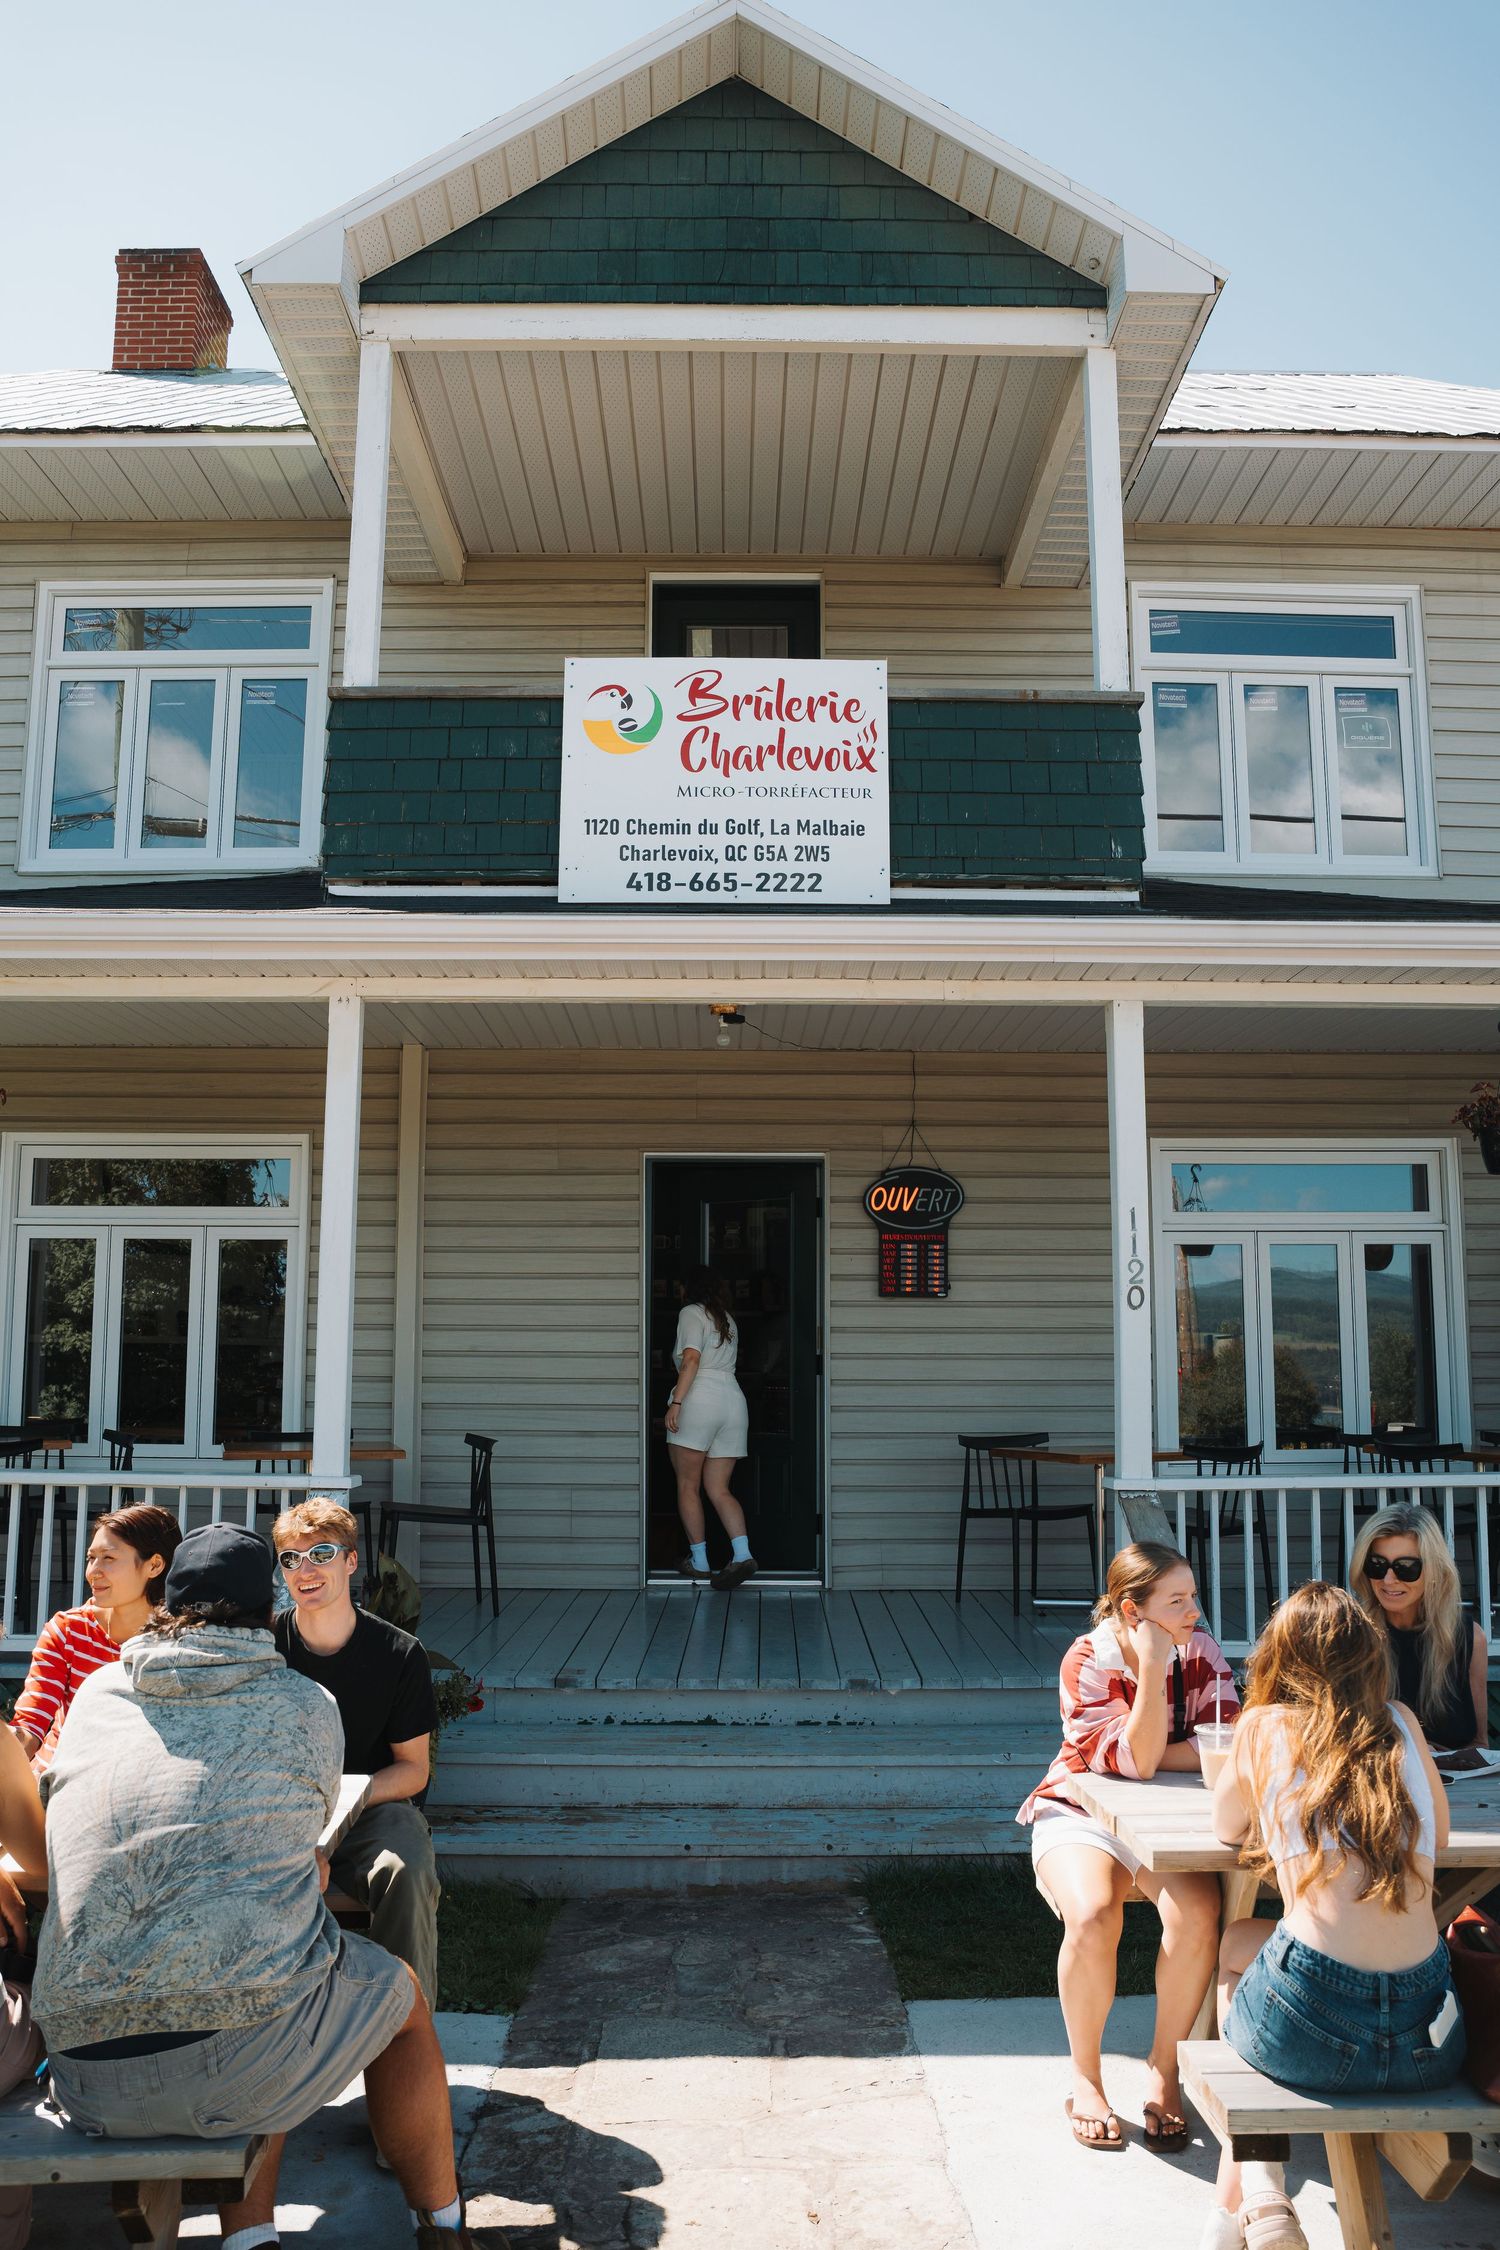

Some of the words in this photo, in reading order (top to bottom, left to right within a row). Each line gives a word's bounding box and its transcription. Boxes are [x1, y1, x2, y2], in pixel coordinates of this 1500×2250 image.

[1151, 621, 1178, 629] Novatech
[674, 669, 867, 724] Brûlerie
[1159, 693, 1186, 701] Novatech
[680, 725, 878, 778] Charlevoix
[584, 818, 620, 836] 1120
[626, 818, 692, 836] Chemin
[698, 818, 719, 836] du
[725, 818, 765, 839] Golf,
[770, 818, 790, 836] La
[796, 818, 866, 837] Malbaie
[619, 844, 719, 864] Charlevoix,
[724, 844, 748, 863] QC
[754, 844, 789, 863] G5A
[794, 844, 830, 863] 2W5
[626, 872, 823, 893] 418-665-2222
[871, 1187, 956, 1212] OUVERT
[1127, 1206, 1145, 1311] 1120
